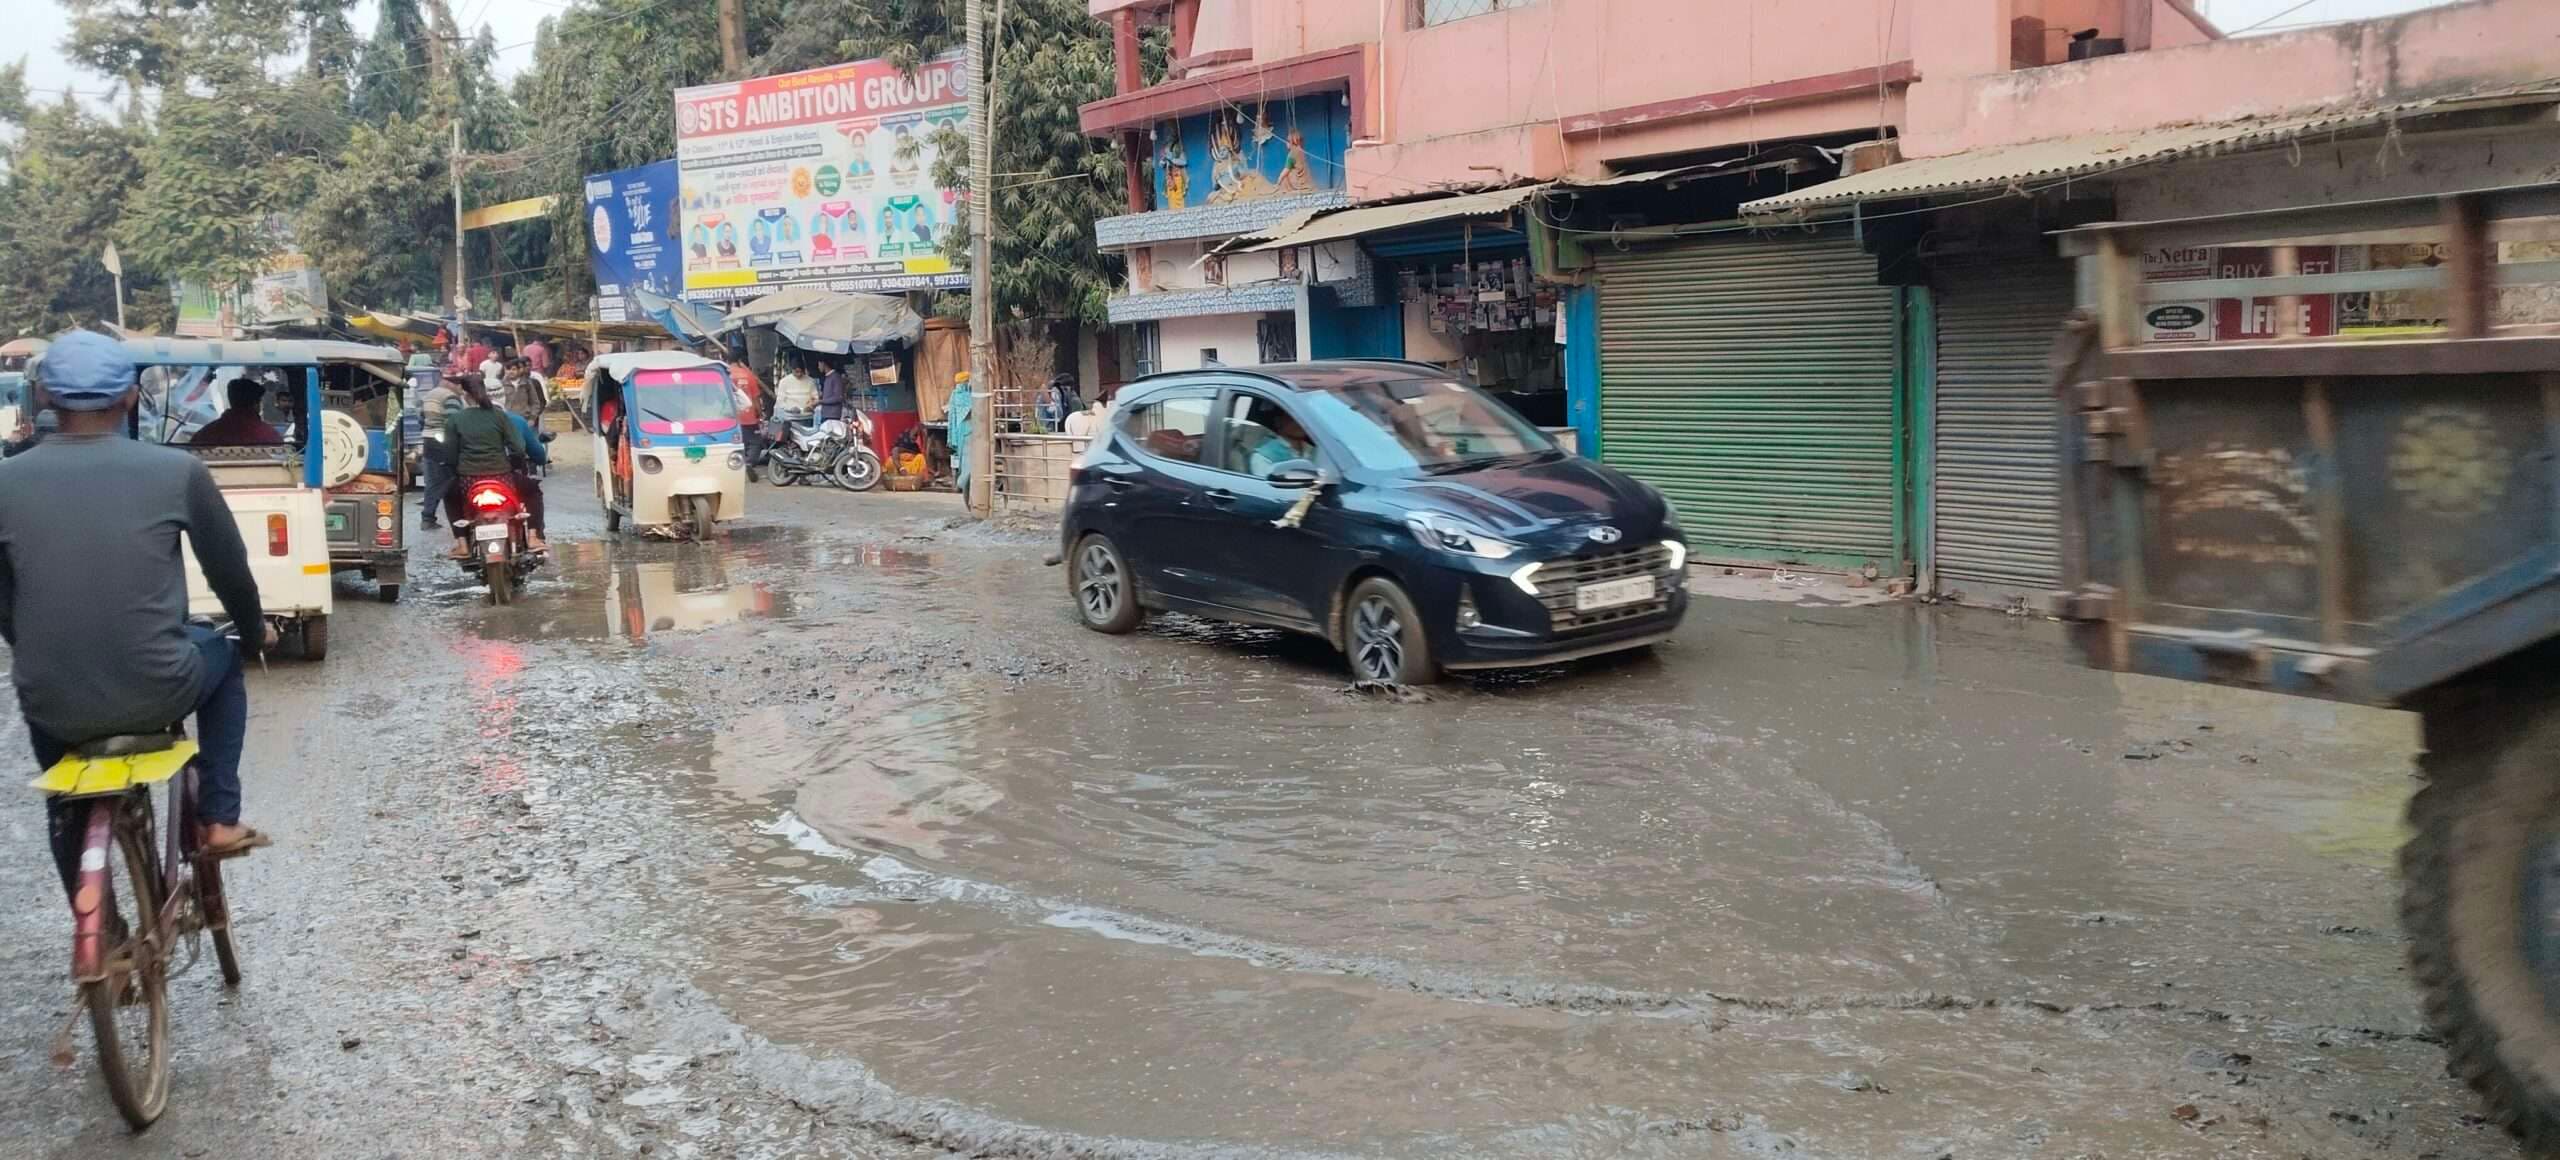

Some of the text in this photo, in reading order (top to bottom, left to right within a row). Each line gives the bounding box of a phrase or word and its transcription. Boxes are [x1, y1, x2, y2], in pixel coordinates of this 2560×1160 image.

[699, 68, 947, 133] STS AMBITION GROUP
[2144, 248, 2207, 264] The Netra
[2222, 264, 2263, 279] BUY
[2253, 304, 2311, 334] FE
